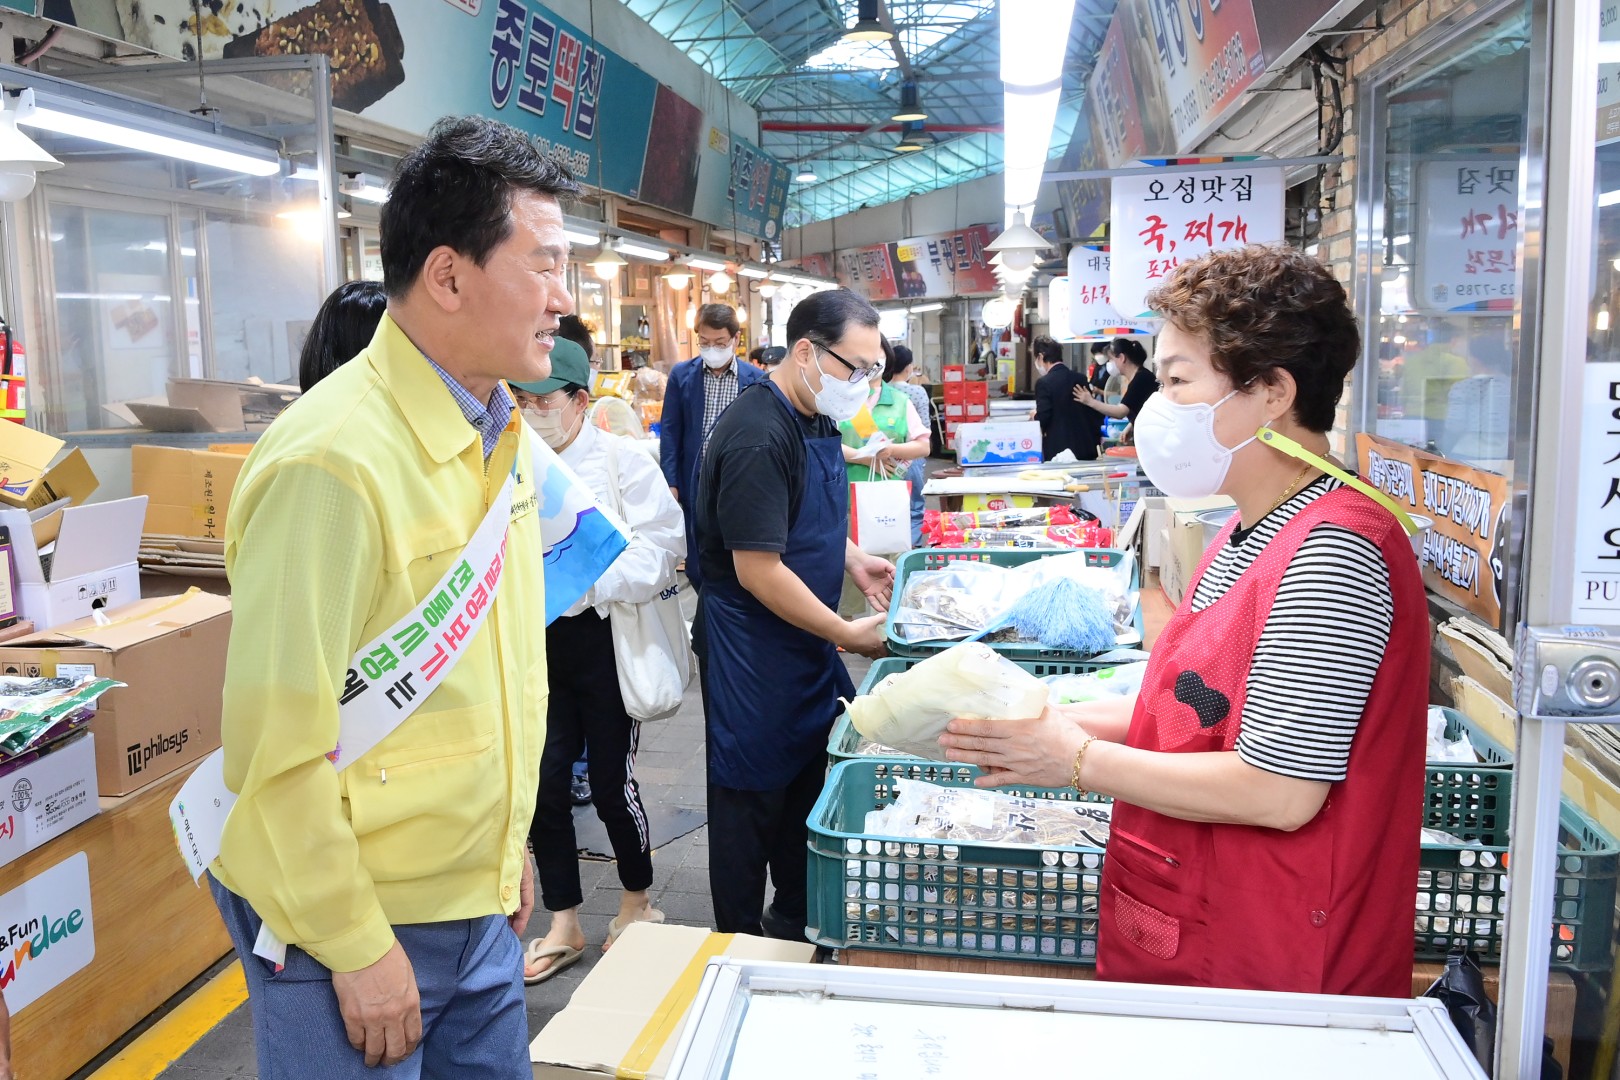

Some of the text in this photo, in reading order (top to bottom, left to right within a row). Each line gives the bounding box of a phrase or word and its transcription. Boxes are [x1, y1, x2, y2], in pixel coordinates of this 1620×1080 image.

[490, 0, 605, 140] 종로떡집
[1143, 174, 1253, 204] 오성맛집
[143, 729, 188, 769] philosys
